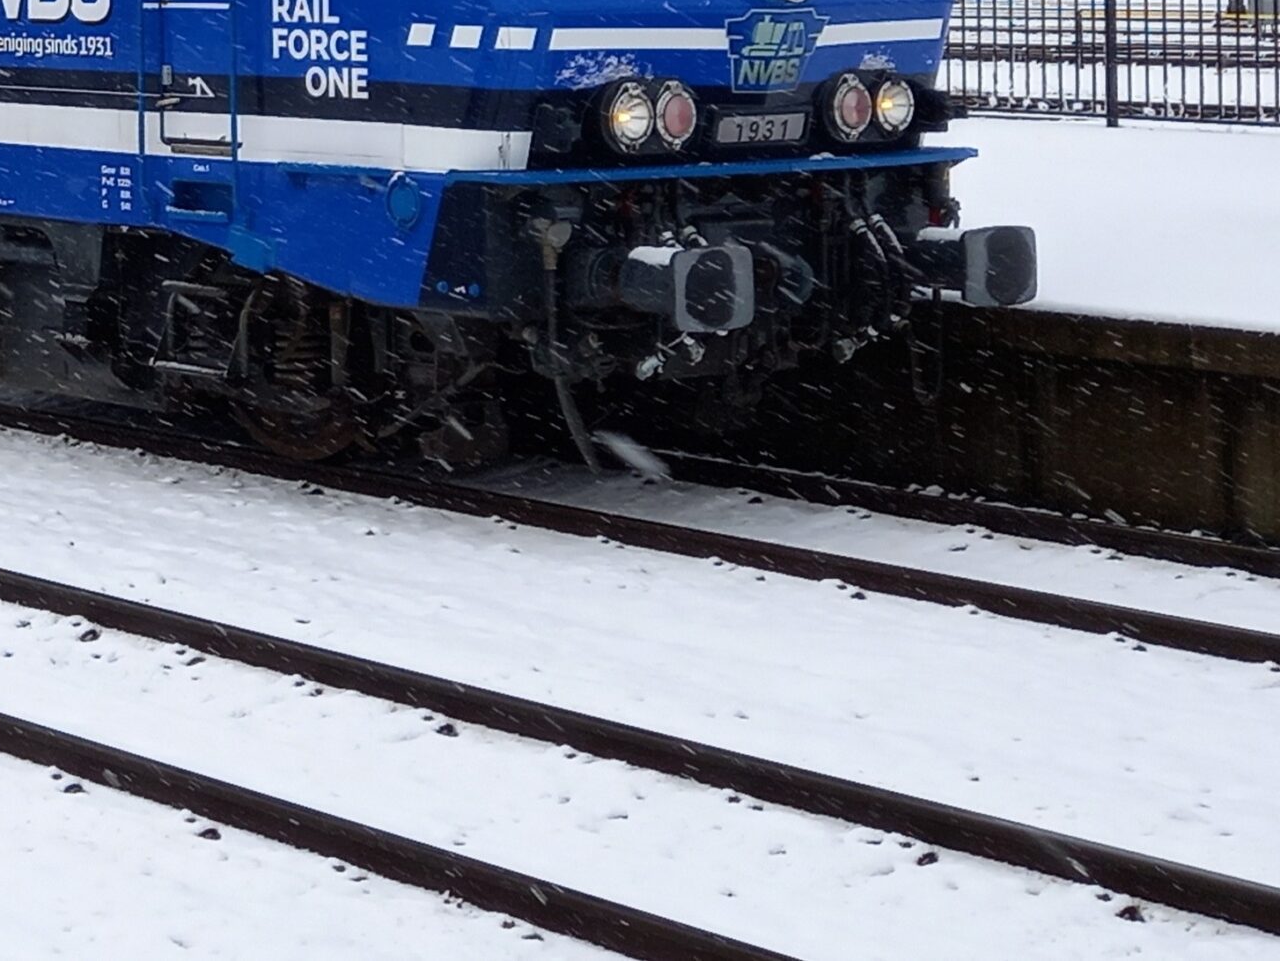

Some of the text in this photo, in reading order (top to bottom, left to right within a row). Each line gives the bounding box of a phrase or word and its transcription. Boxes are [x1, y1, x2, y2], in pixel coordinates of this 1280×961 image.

[44, 33, 78, 56] sinds
[79, 36, 113, 56] 1931
[272, 27, 368, 62] FORCE
[305, 66, 369, 100] ONE
[737, 58, 801, 85] NVBS
[735, 119, 790, 141] 1931
